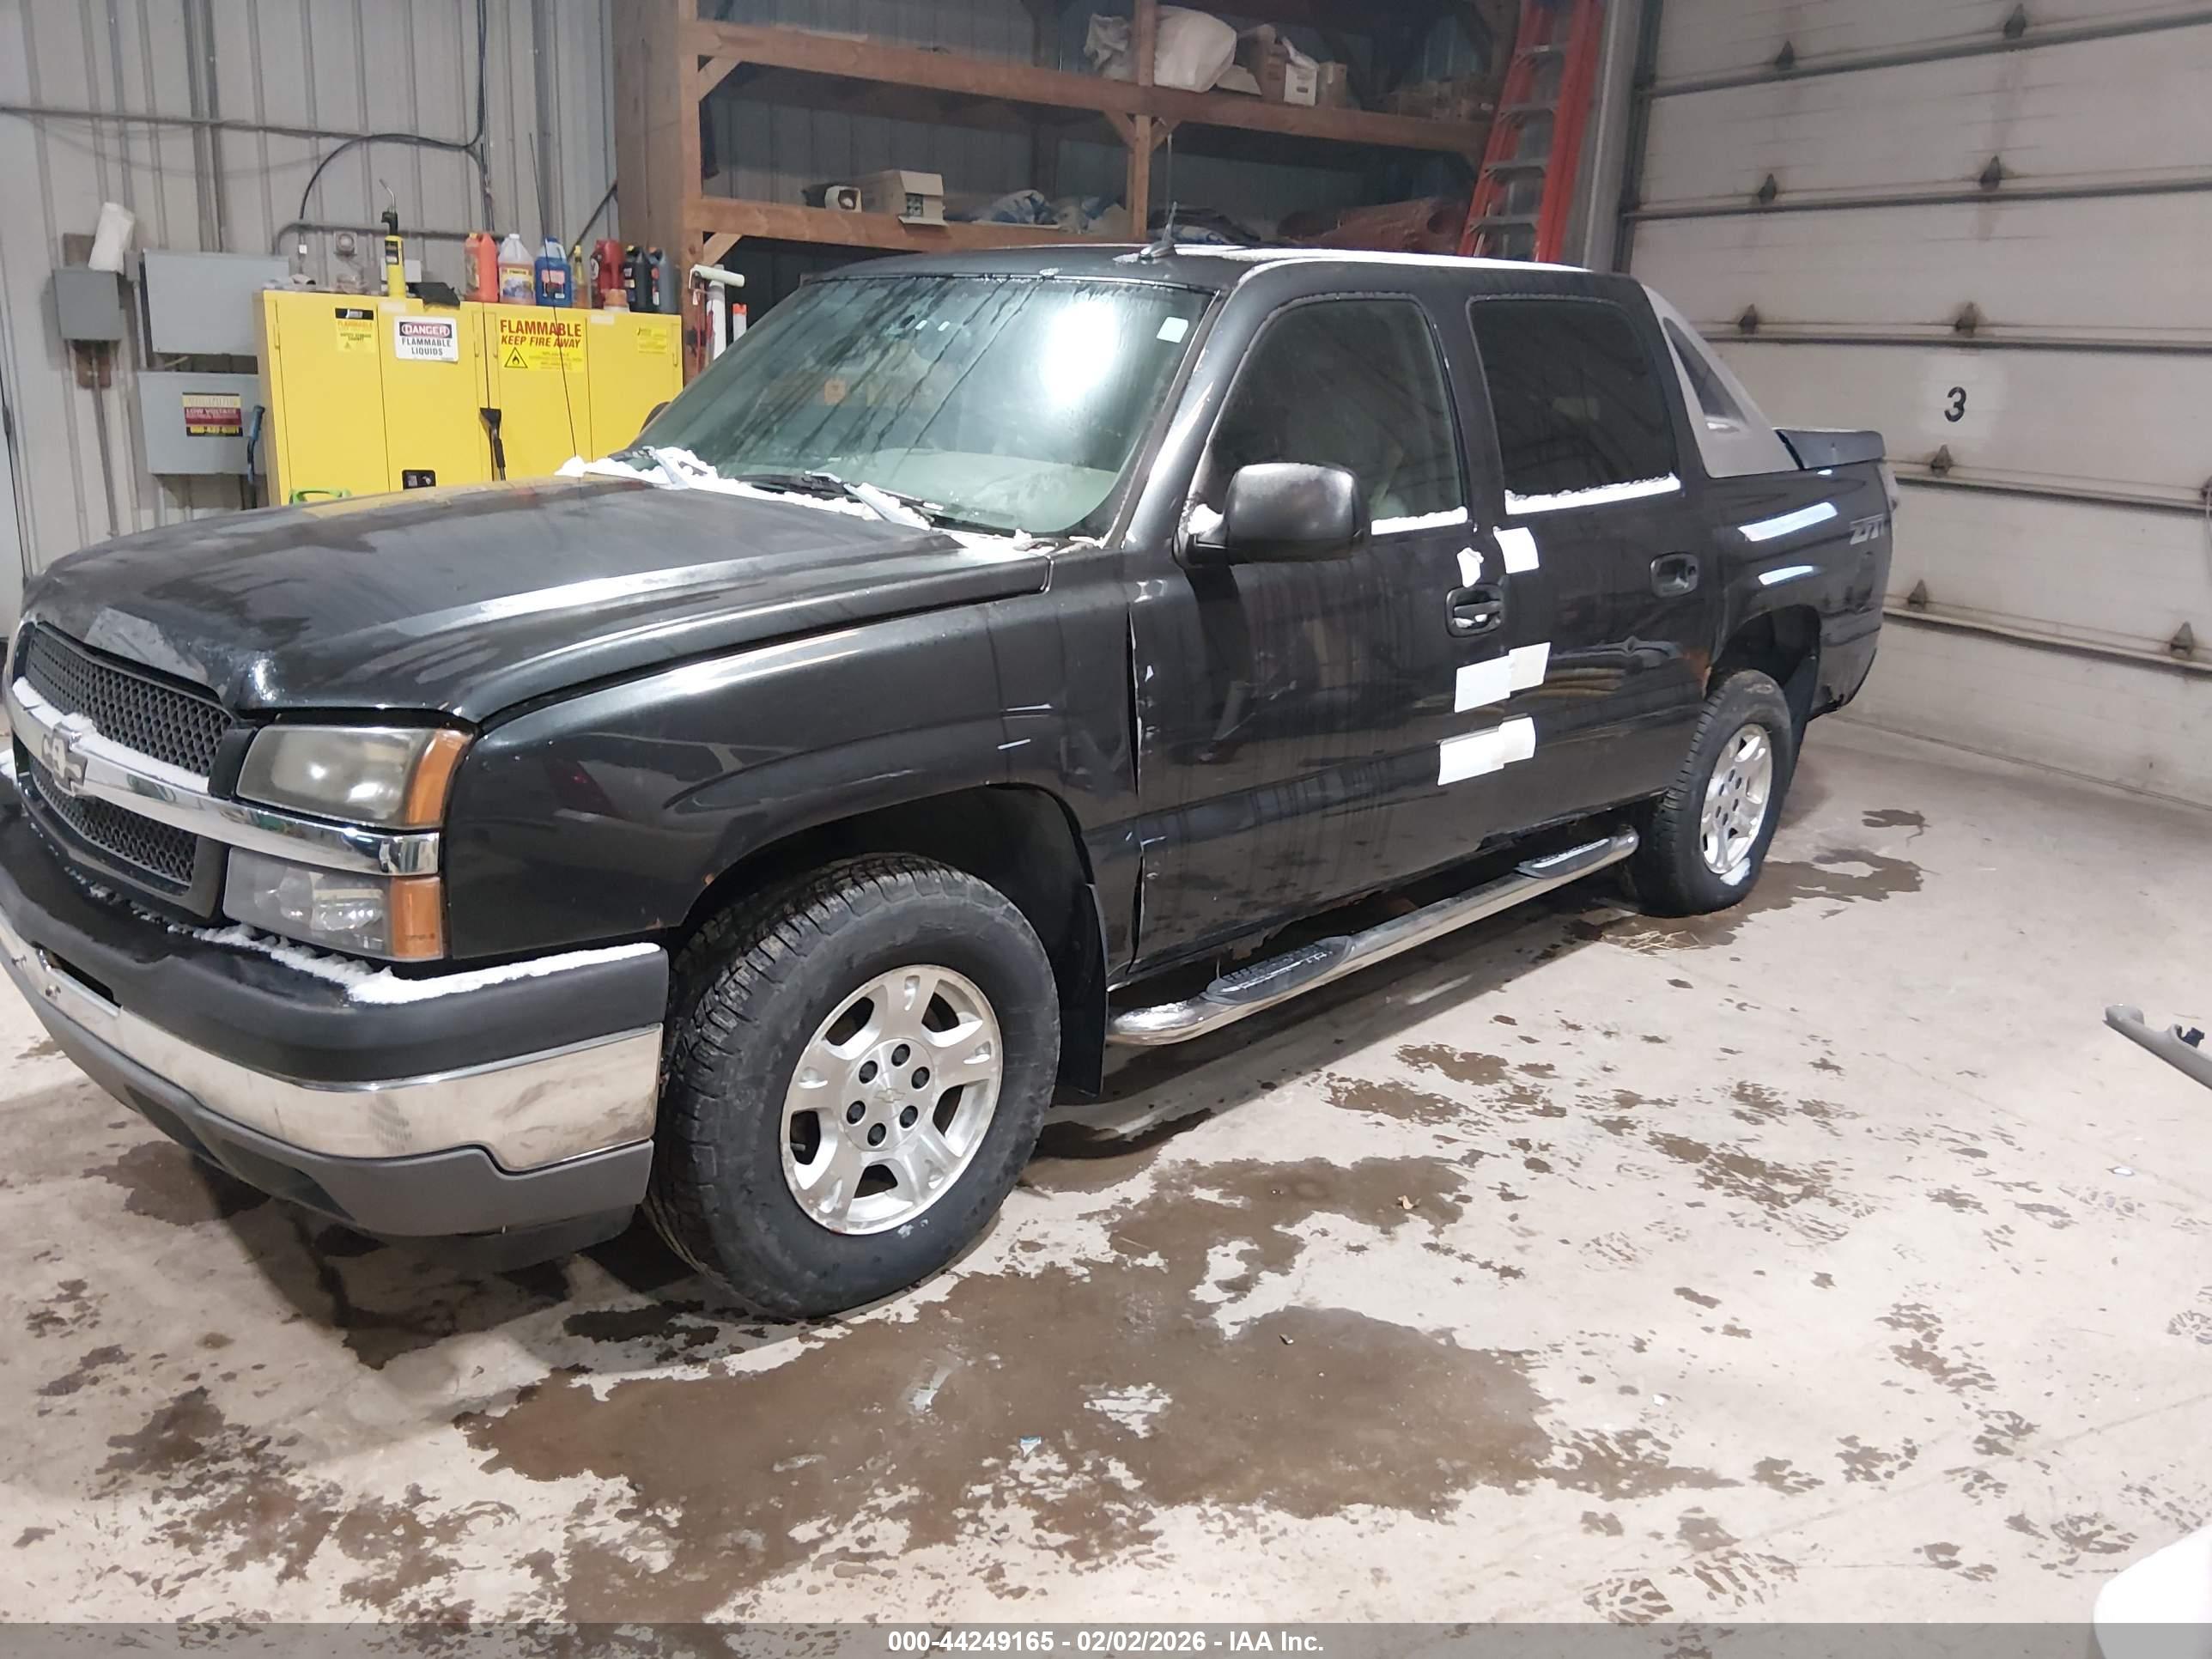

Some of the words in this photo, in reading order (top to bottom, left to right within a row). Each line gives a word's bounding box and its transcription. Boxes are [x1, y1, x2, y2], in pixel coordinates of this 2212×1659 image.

[404, 324, 447, 337] DANGER
[500, 319, 582, 337] FLAMMABLE
[402, 337, 452, 348] FLAMMABLE
[501, 335, 527, 345] KEEP
[529, 336, 551, 347] FIRE
[554, 337, 581, 349] AWAY
[411, 347, 444, 356] LIQUIDS
[1944, 386, 1966, 422] 3
